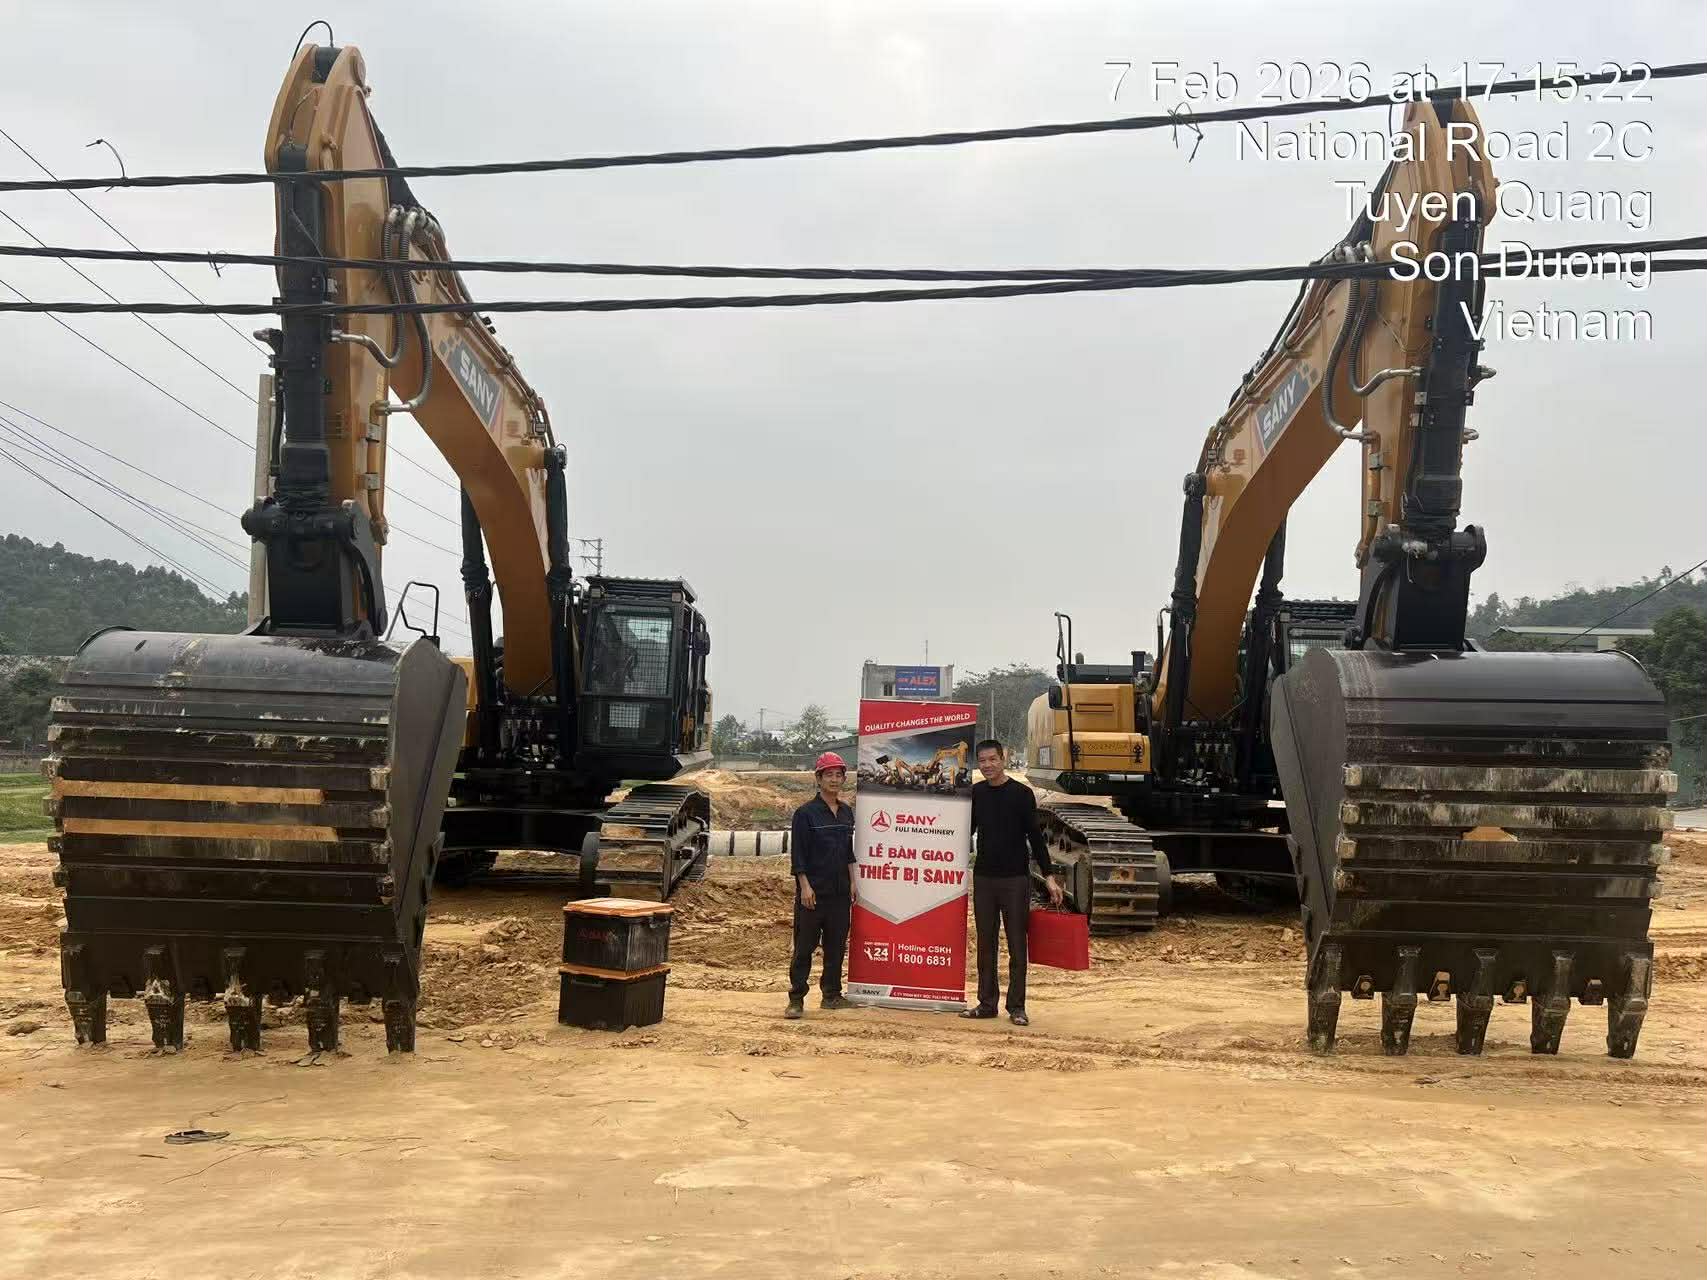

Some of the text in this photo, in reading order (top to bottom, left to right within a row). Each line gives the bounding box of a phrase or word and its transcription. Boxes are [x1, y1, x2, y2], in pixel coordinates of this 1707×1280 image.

[460, 349, 494, 414] SANY
[1263, 375, 1297, 441] SANY
[864, 713, 971, 732] QUALITY CHANGES THE WORLD
[895, 814, 937, 825] SANY
[911, 827, 955, 836] MACHINERY
[888, 846, 917, 860] BÀN
[921, 850, 955, 862] GIAO
[859, 861, 965, 885] THIẾT BỊ SANY
[873, 948, 889, 957] 24
[898, 943, 926, 953] Hotline
[928, 945, 952, 954] CSKH
[898, 953, 952, 967] 1800 6831
